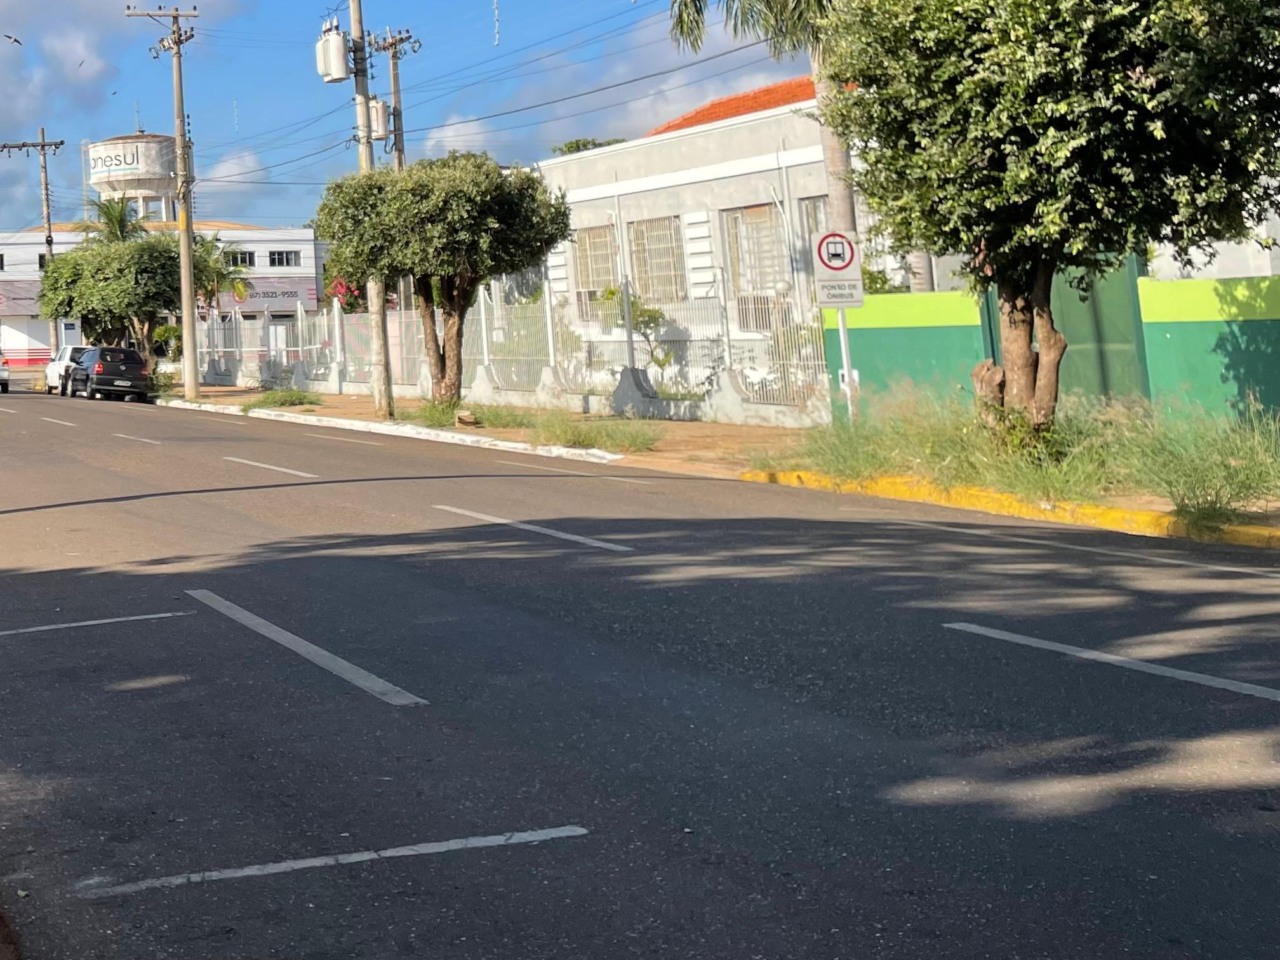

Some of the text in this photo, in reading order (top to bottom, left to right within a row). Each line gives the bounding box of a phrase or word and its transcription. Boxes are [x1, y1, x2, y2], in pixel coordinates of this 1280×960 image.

[821, 283, 858, 292] PONTO DE
[826, 291, 855, 300] ÔNIBUS
